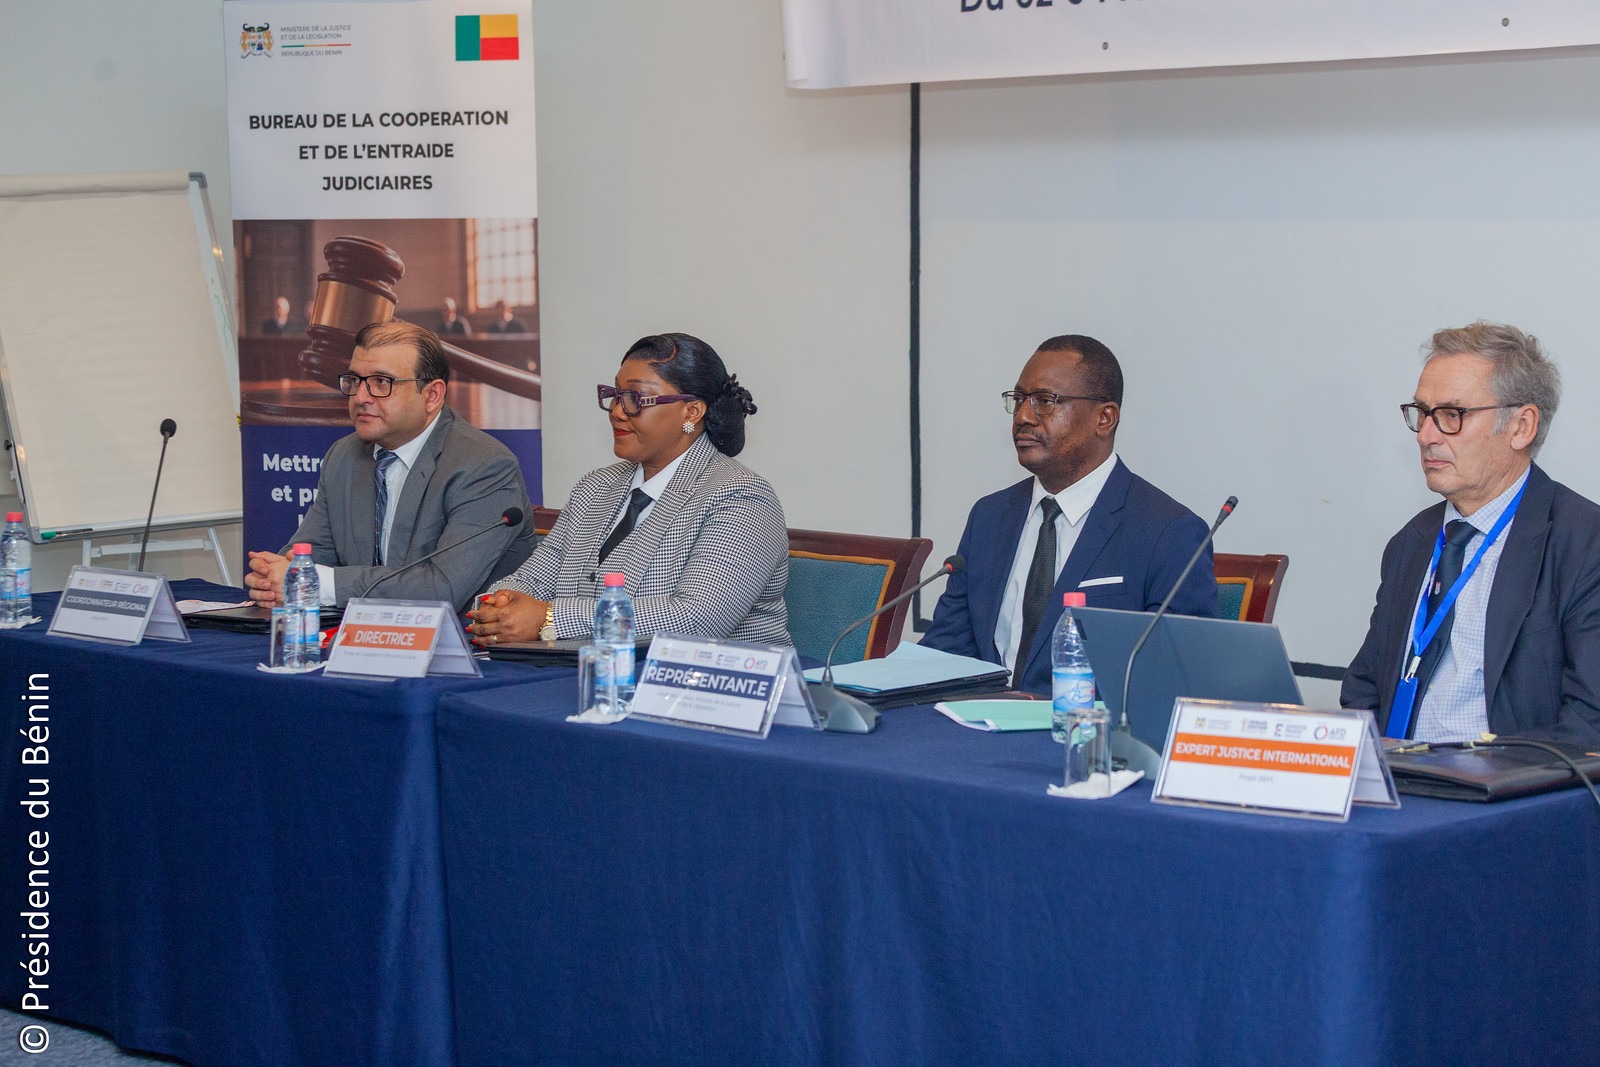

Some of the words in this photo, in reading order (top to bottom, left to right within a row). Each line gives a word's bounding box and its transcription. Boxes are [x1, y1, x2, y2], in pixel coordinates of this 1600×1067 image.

[249, 114, 317, 129] BUREAU
[323, 114, 347, 128] DE
[352, 113, 374, 127] LA
[379, 110, 509, 127] COOPERATION
[298, 145, 319, 160] ET
[324, 144, 348, 159] DE
[322, 175, 433, 191] JUDICIAIRES
[263, 453, 323, 472] Mettr
[271, 485, 293, 502] et
[118, 599, 147, 611] RÉGIONAL
[354, 630, 416, 646] DIRECTRICE
[646, 665, 769, 697] REPRÉSENTANT.E
[1175, 742, 1216, 757] EXPERT
[1217, 745, 1260, 761] JUSTICE
[1262, 749, 1351, 769] INTERNATIONAL
